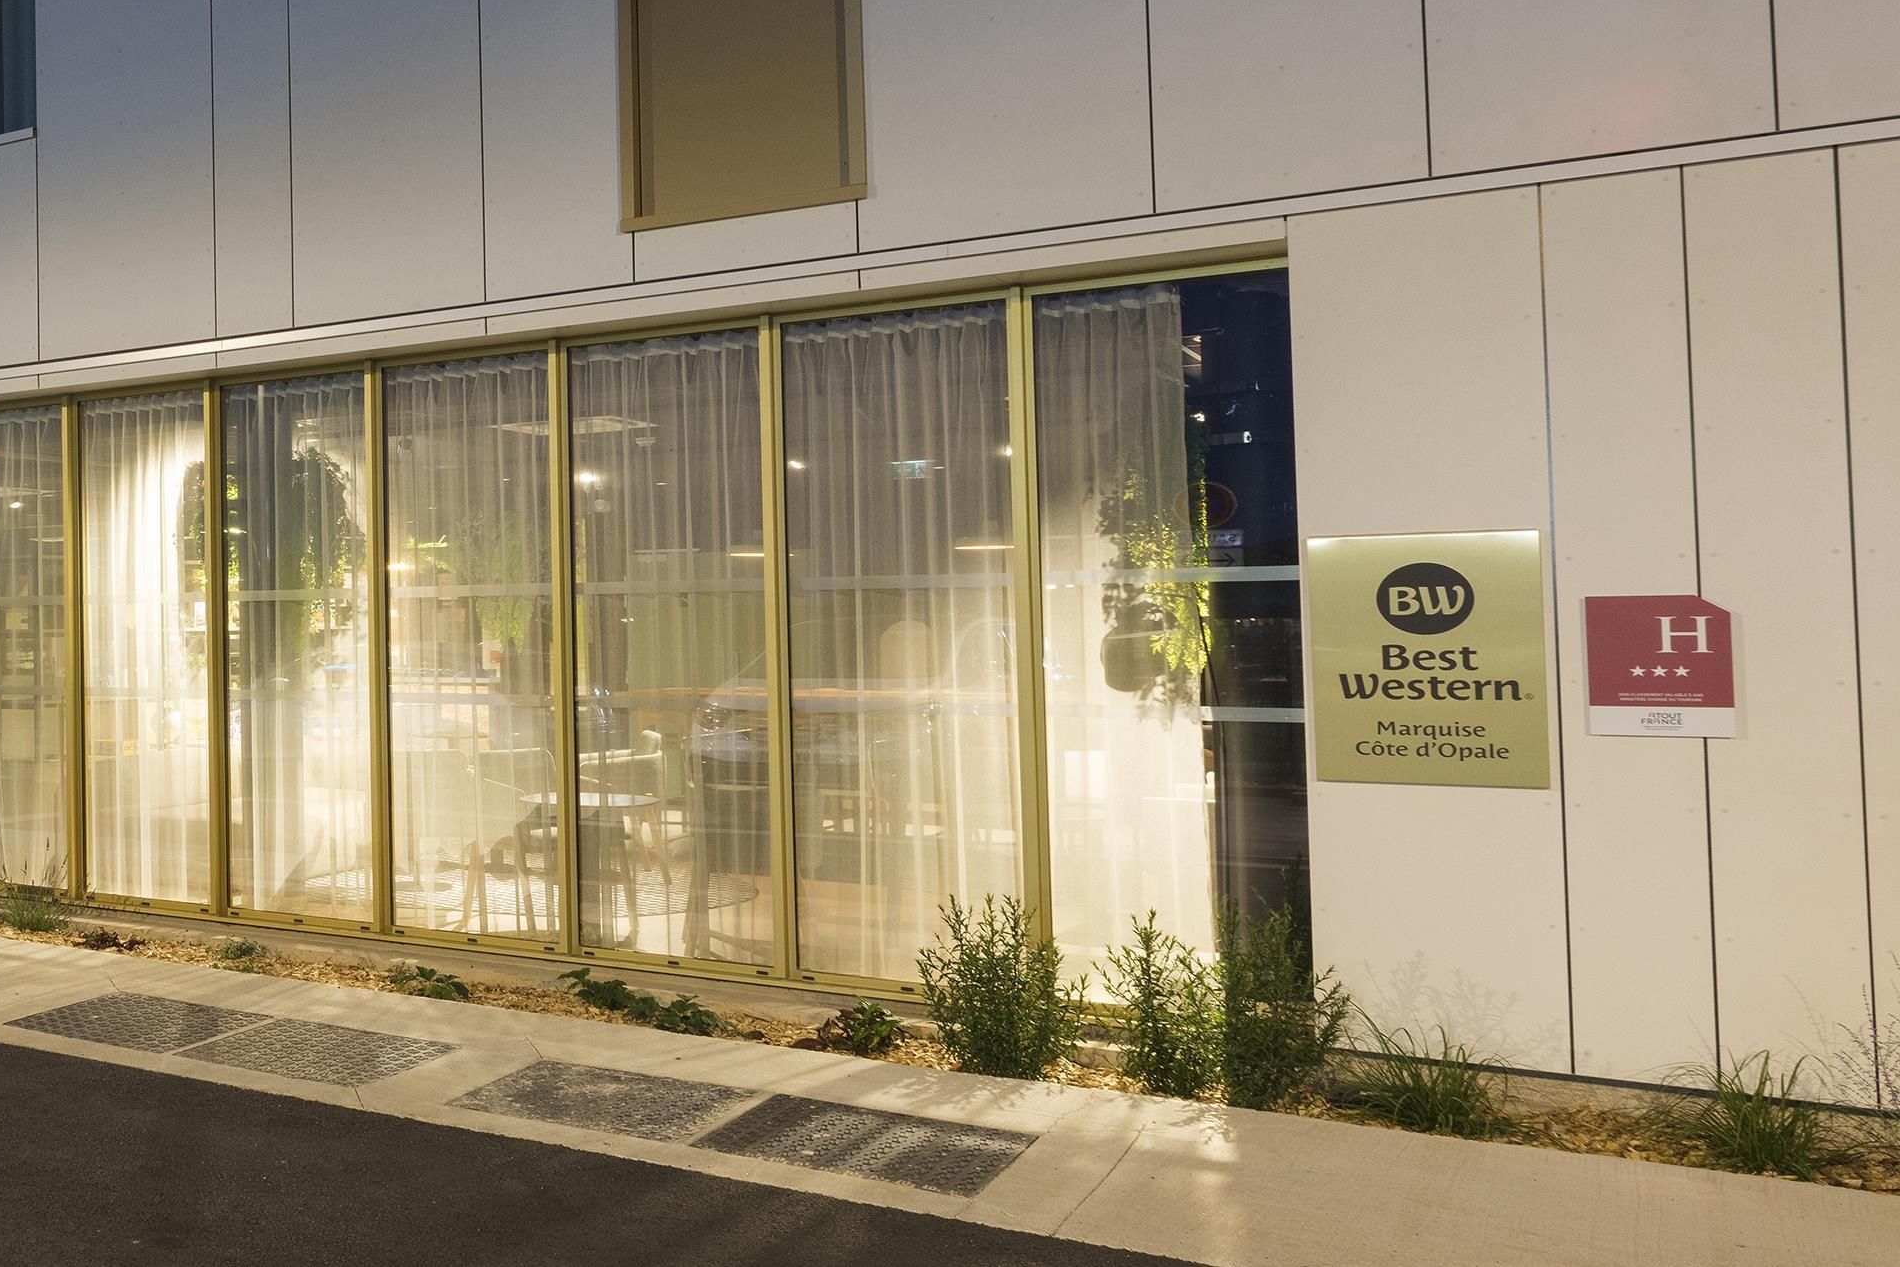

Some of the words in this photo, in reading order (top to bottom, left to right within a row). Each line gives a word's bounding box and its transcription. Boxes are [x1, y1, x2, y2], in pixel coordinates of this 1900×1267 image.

[1388, 585, 1465, 616] BW
[1654, 615, 1714, 654] H
[1381, 644, 1479, 671] Best
[1377, 721, 1486, 740] Marquise
[1355, 740, 1408, 756] Côte
